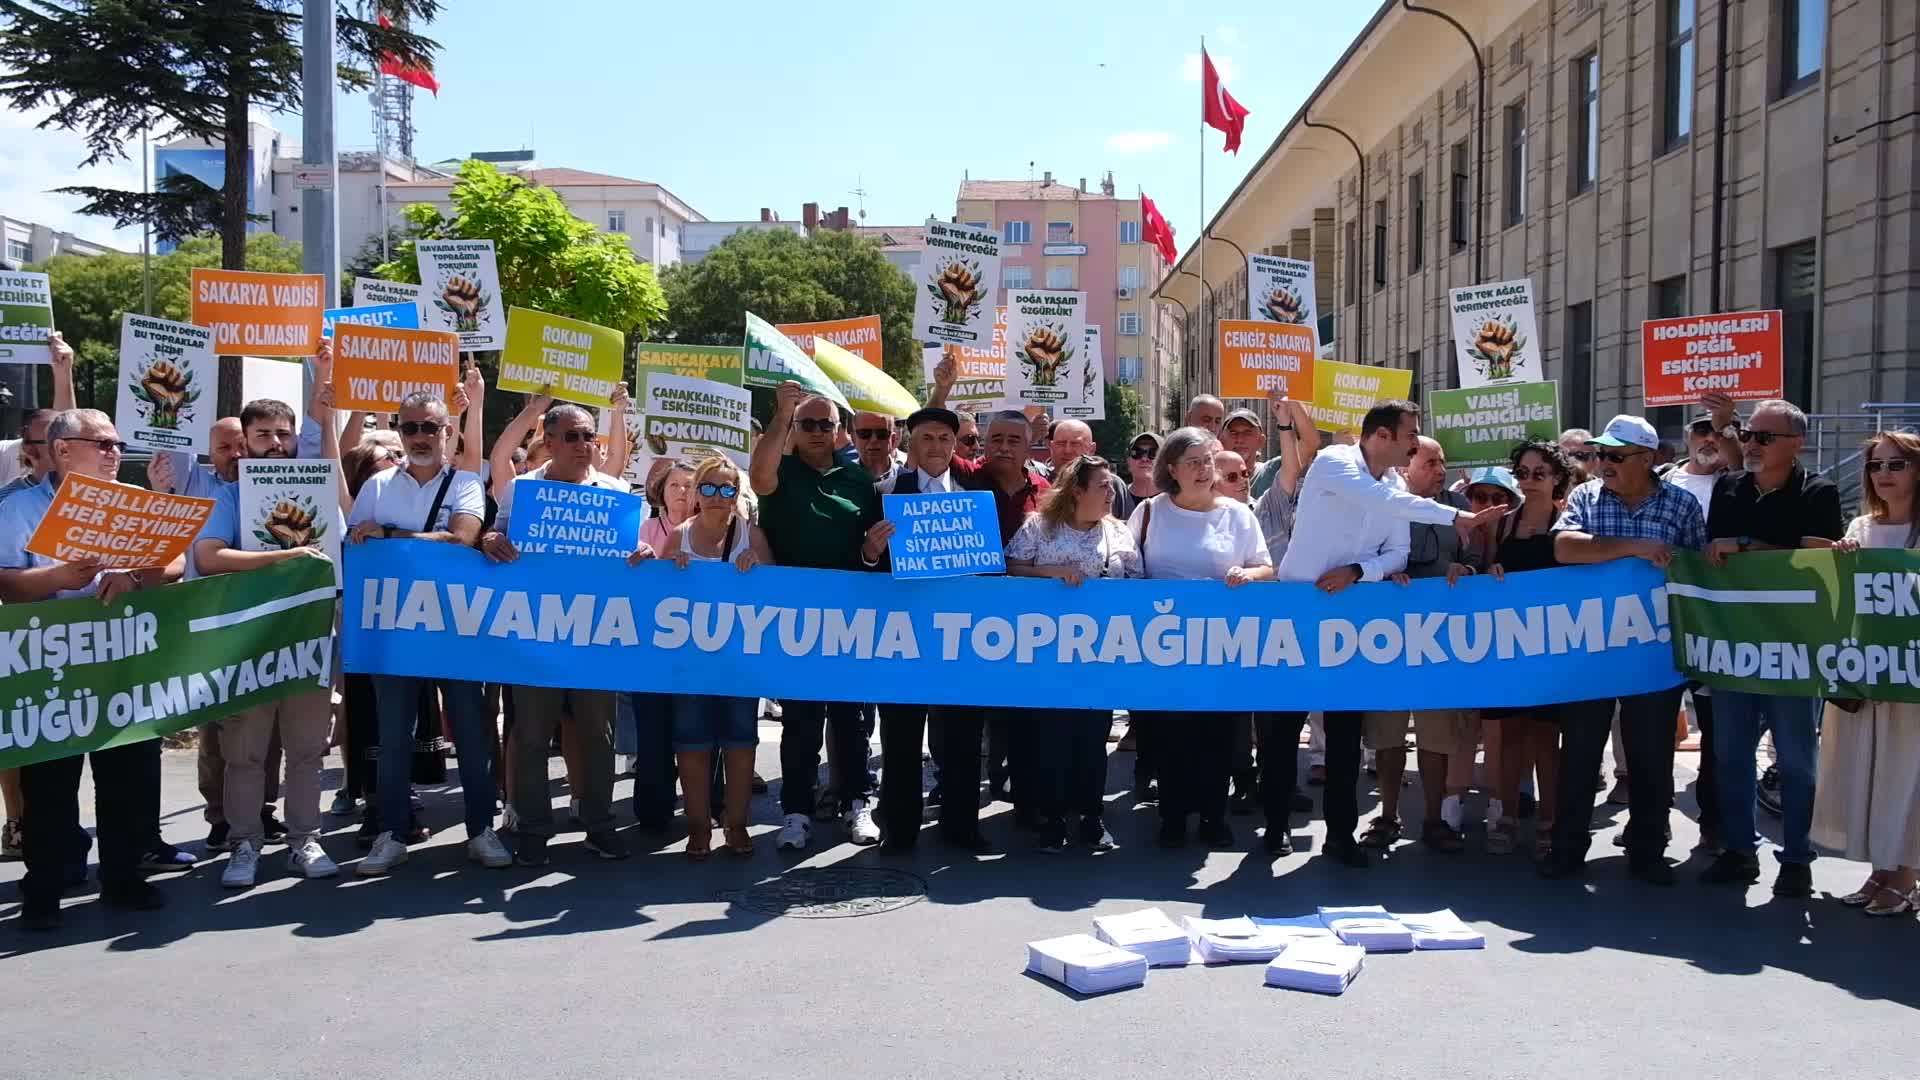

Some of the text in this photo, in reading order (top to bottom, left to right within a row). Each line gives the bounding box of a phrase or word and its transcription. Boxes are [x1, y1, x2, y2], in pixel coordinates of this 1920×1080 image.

[969, 231, 998, 245] AĞACI
[6, 278, 43, 288] YOK ET
[199, 280, 319, 308] SAKARYA VADİSİ
[1456, 291, 1473, 302] BİR
[1496, 285, 1525, 297] AĞACI
[1016, 293, 1078, 307] DOĞA YAŞAM
[1021, 305, 1073, 316] ÖZGÜRLÜK!
[208, 322, 309, 346] YOK OLMASIN
[1653, 313, 1769, 340] HOLDİNGLERİ
[543, 326, 592, 350] ROKAMI
[1225, 328, 1311, 352] CENGİZ SAKARYA
[1686, 335, 1736, 355] DEĞİL
[341, 335, 454, 365] SAKARYA VADİSİ
[961, 345, 1007, 358] CENGİ
[960, 361, 1007, 376] VERME
[1240, 351, 1300, 372] VADİSİNDEN
[1661, 351, 1762, 376] ESKİŞEHİR'İ
[504, 362, 560, 387] MADENE
[1257, 374, 1288, 393] DEFOL
[1333, 371, 1380, 392] ROKAMI
[1683, 373, 1740, 392] KORU!
[348, 378, 378, 400] YOK
[652, 387, 735, 409] ÇANAKKALE'YE
[736, 401, 748, 412] DE
[661, 400, 741, 422] ESKİŞEHİR'E DE
[1436, 401, 1553, 429] MADENCİLİĞE
[650, 420, 745, 449] DOKUNMA!
[1465, 424, 1526, 443] HAYIR!
[246, 463, 331, 474] SAKARYA VADİSİ
[252, 475, 326, 485] YOK OLMASIN!
[69, 481, 208, 520] YEŞİLLİĞİMİZ
[535, 487, 620, 509] ALPAGUT-
[903, 499, 977, 517] ALPAGUT-
[58, 502, 197, 538] HER ŞEYİMİZ
[541, 506, 609, 526] ATALAN
[912, 516, 974, 534] ATALAN
[528, 521, 618, 545] SİYANÜRÜ
[905, 532, 985, 553] SİYANÜRÜ
[153, 540, 170, 553] E
[895, 550, 1001, 572] HAK ETMİYOR
[1854, 572, 1920, 617] ESK
[361, 577, 1672, 668] HAVAMA SUYUMA TOPRAĞIMA DOKUNMA!
[0, 604, 159, 682] KİŞEHİR
[1684, 632, 1920, 693] MADEN ÇÖPLÜ
[0, 686, 99, 750] LÜĞÜ
